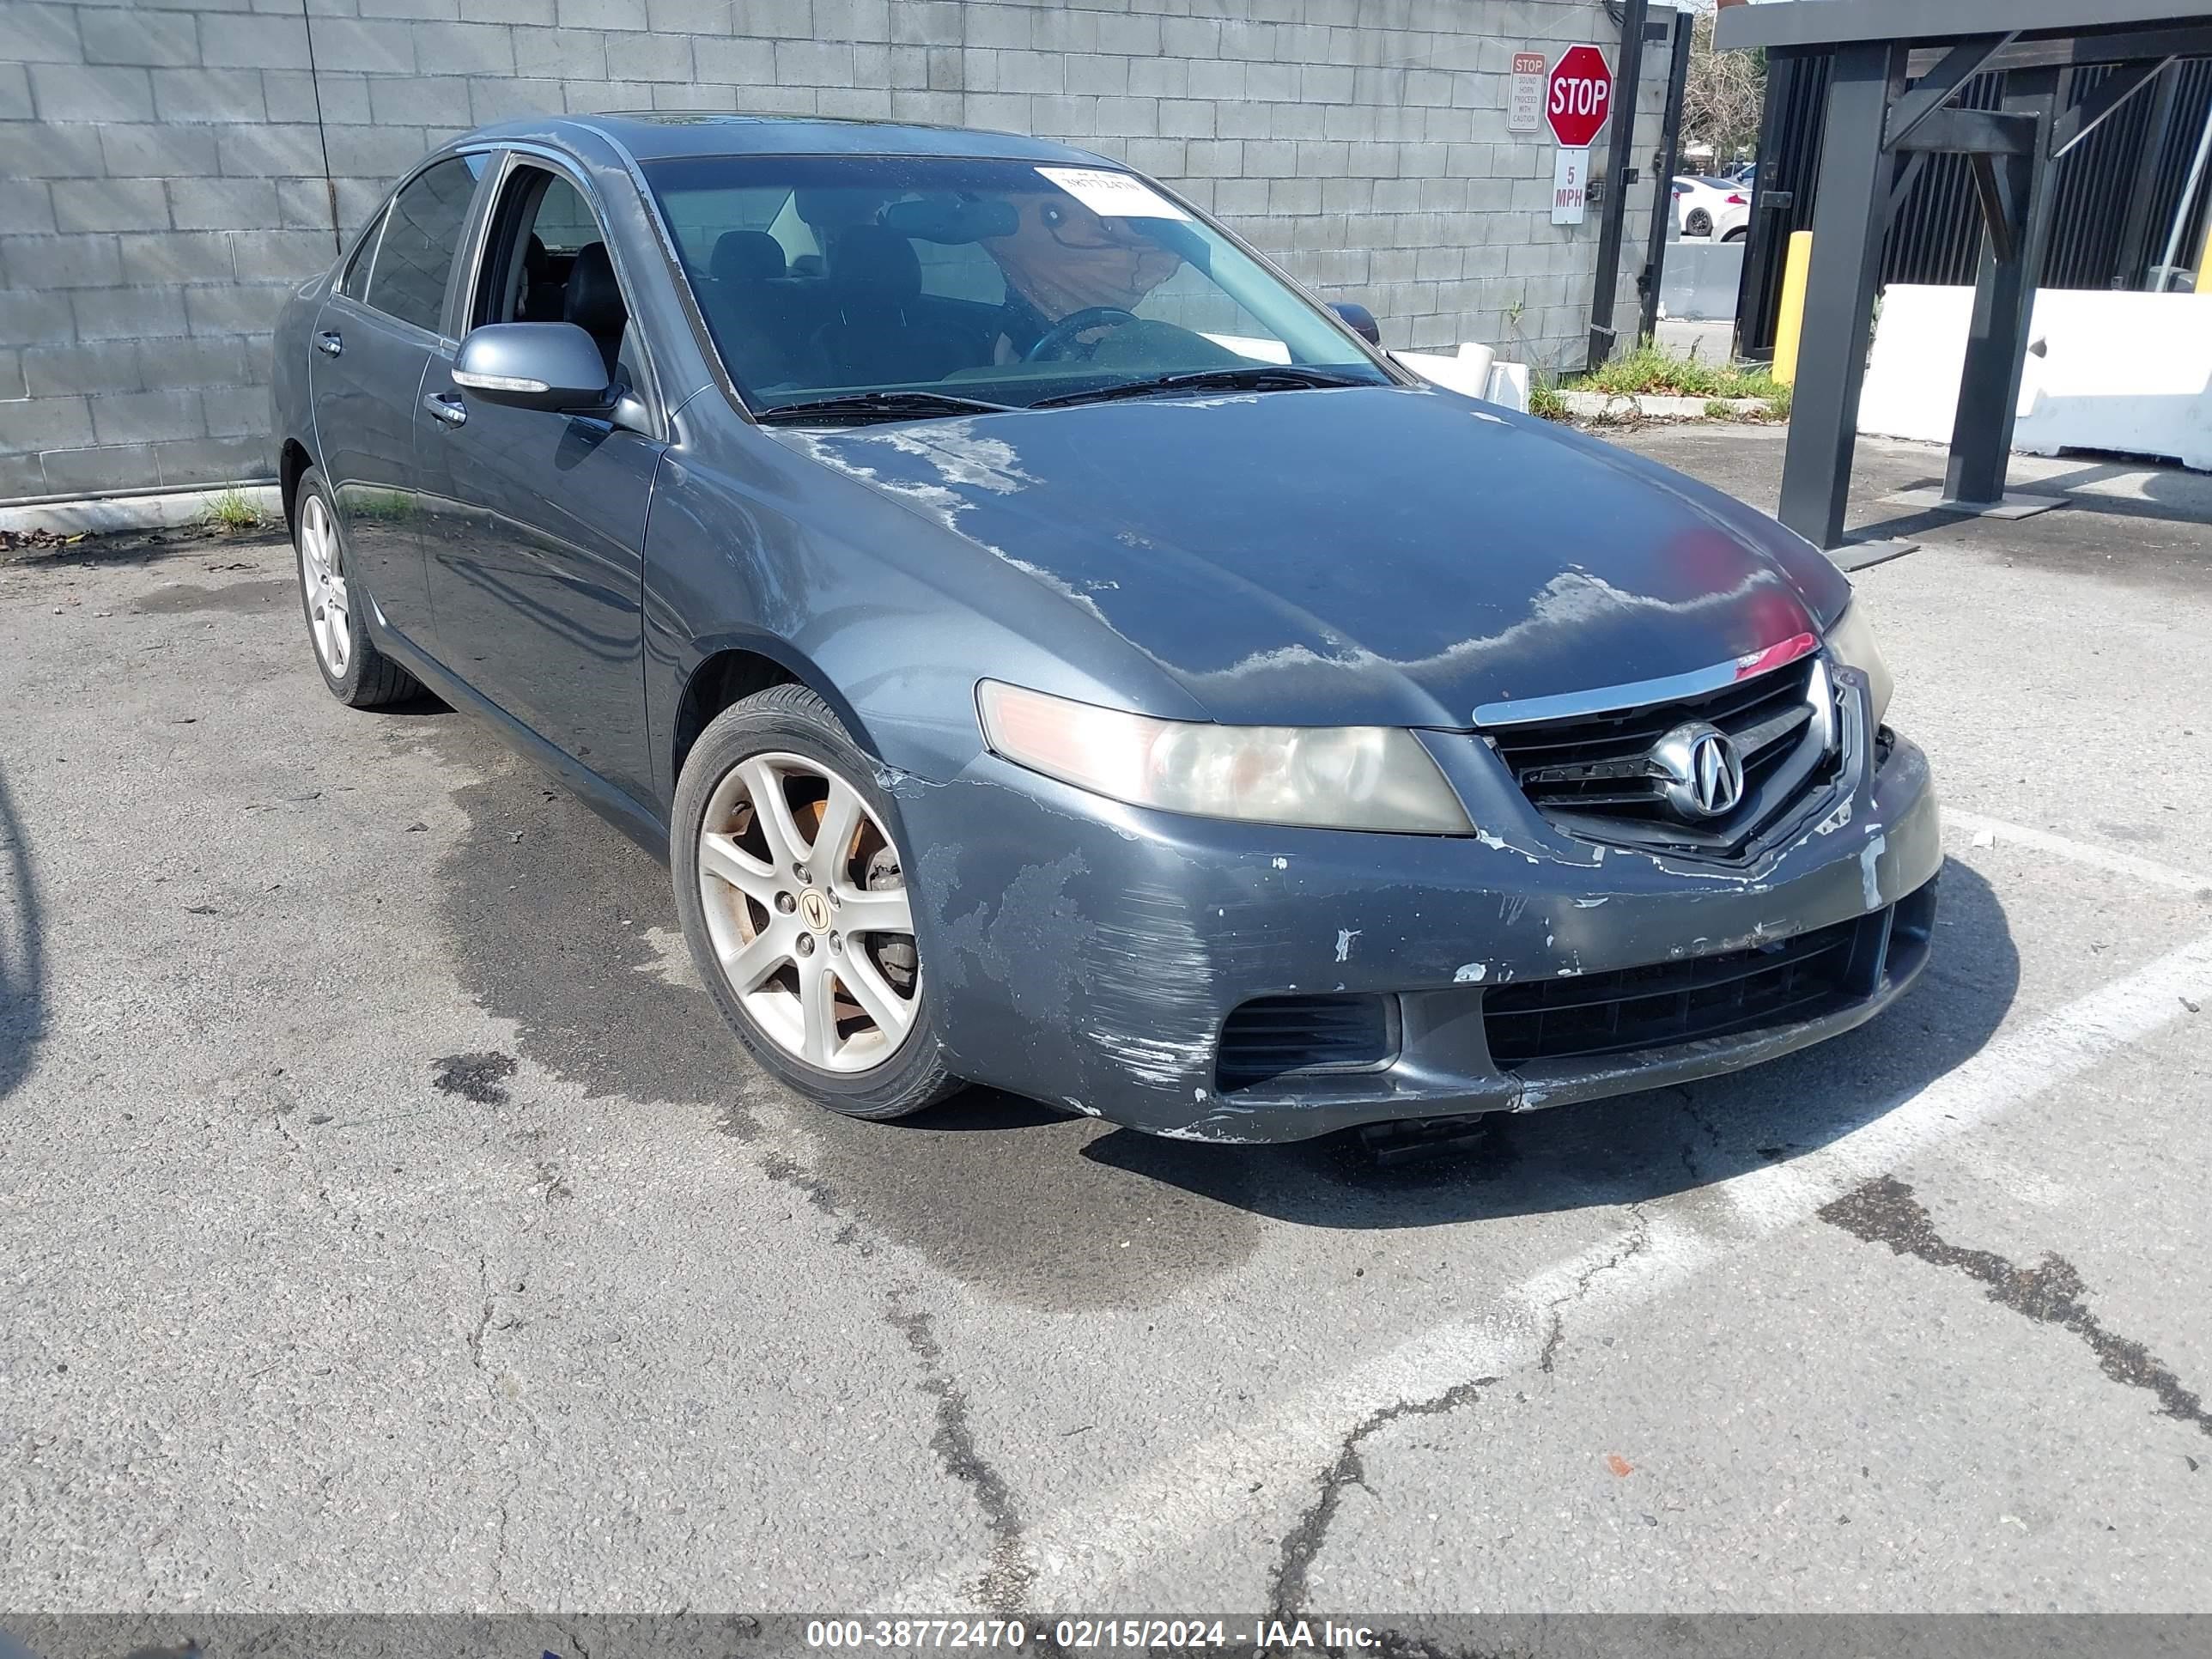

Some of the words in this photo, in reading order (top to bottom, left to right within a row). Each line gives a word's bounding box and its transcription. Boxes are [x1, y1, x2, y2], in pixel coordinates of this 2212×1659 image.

[1516, 58, 1543, 73] STOP
[1519, 86, 1534, 94] HORN
[1552, 77, 1607, 115] STOP
[1514, 95, 1538, 104] PROCEED
[1518, 105, 1531, 113] WITH
[1513, 114, 1535, 123] CAUTION
[1567, 166, 1575, 185] 5
[1555, 189, 1583, 208] MPH
